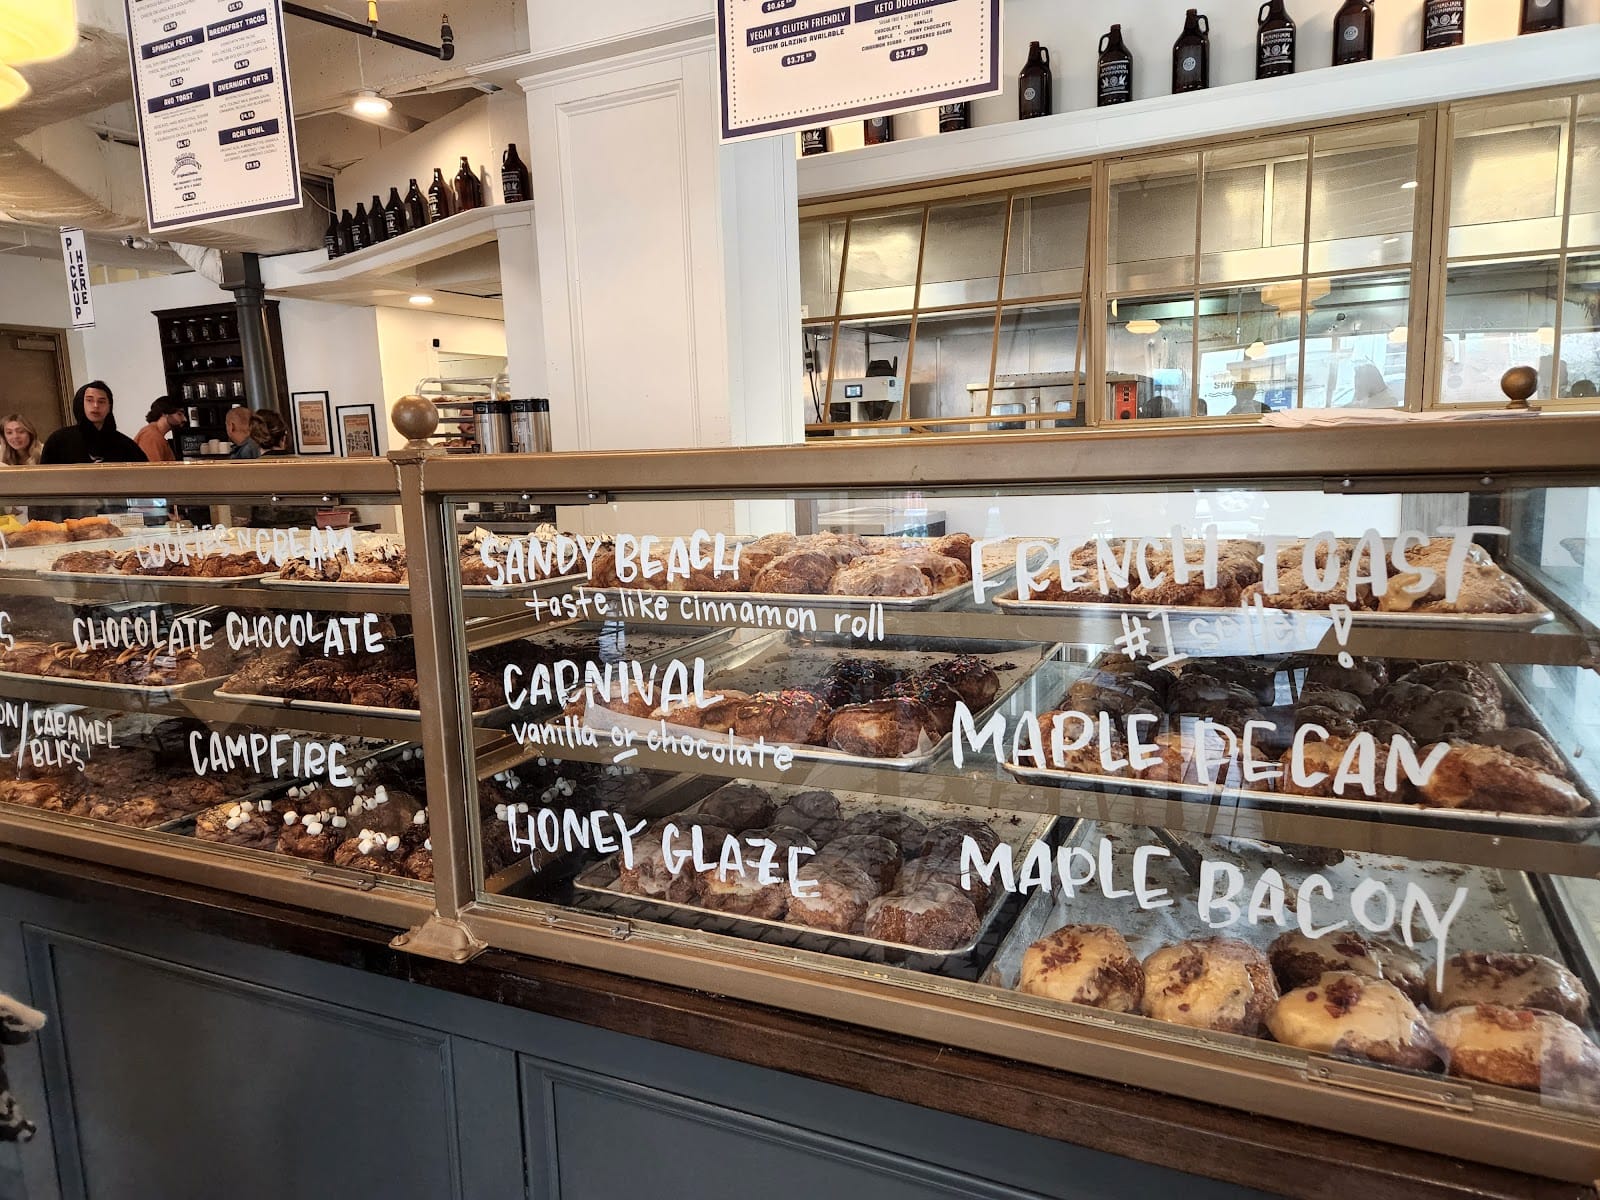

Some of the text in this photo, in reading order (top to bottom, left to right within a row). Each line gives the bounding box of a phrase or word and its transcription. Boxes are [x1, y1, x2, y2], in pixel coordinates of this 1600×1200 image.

[209, 14, 265, 37] BREAKFAST TACOS
[750, 12, 846, 41] VEGAN & GLUTEN FRIENDLY
[874, 1, 894, 14] KETO
[874, 18, 933, 34] CHOCOLATE VANILLA
[924, 21, 951, 31] CHOCOLATE
[152, 35, 193, 53] SPINACH PESTO
[753, 28, 845, 53] CUSTOM GLAZING AVAILABLE
[786, 55, 805, 65] $3.75
[895, 48, 915, 59] $3.75
[164, 92, 193, 106] AVO TOAST
[217, 73, 269, 92] OVERNIGHT OATS
[232, 126, 264, 139] ACAI BOWL
[65, 238, 82, 319] PICKUP
[76, 249, 88, 305] HERE
[134, 523, 232, 568] COOKIES
[255, 525, 356, 571] CREAM
[480, 529, 743, 586] SANDY BEACH
[970, 523, 1511, 604] FRENCH TOAST
[73, 610, 214, 656] CHOCOLATE
[226, 611, 385, 658] CHOCOLATE
[524, 588, 884, 642] taste like cinnamon roll
[504, 657, 725, 712] CARNIVAL
[30, 738, 86, 772] BLISS
[33, 708, 121, 759] CARAMEL
[511, 714, 794, 772] vanilla or chocolate
[952, 701, 1451, 796] MAPLE PECAN
[189, 730, 354, 788] CAMPFIRE
[507, 805, 822, 898] HONEY GLAZE
[960, 835, 1468, 994] MAPLE BACON
